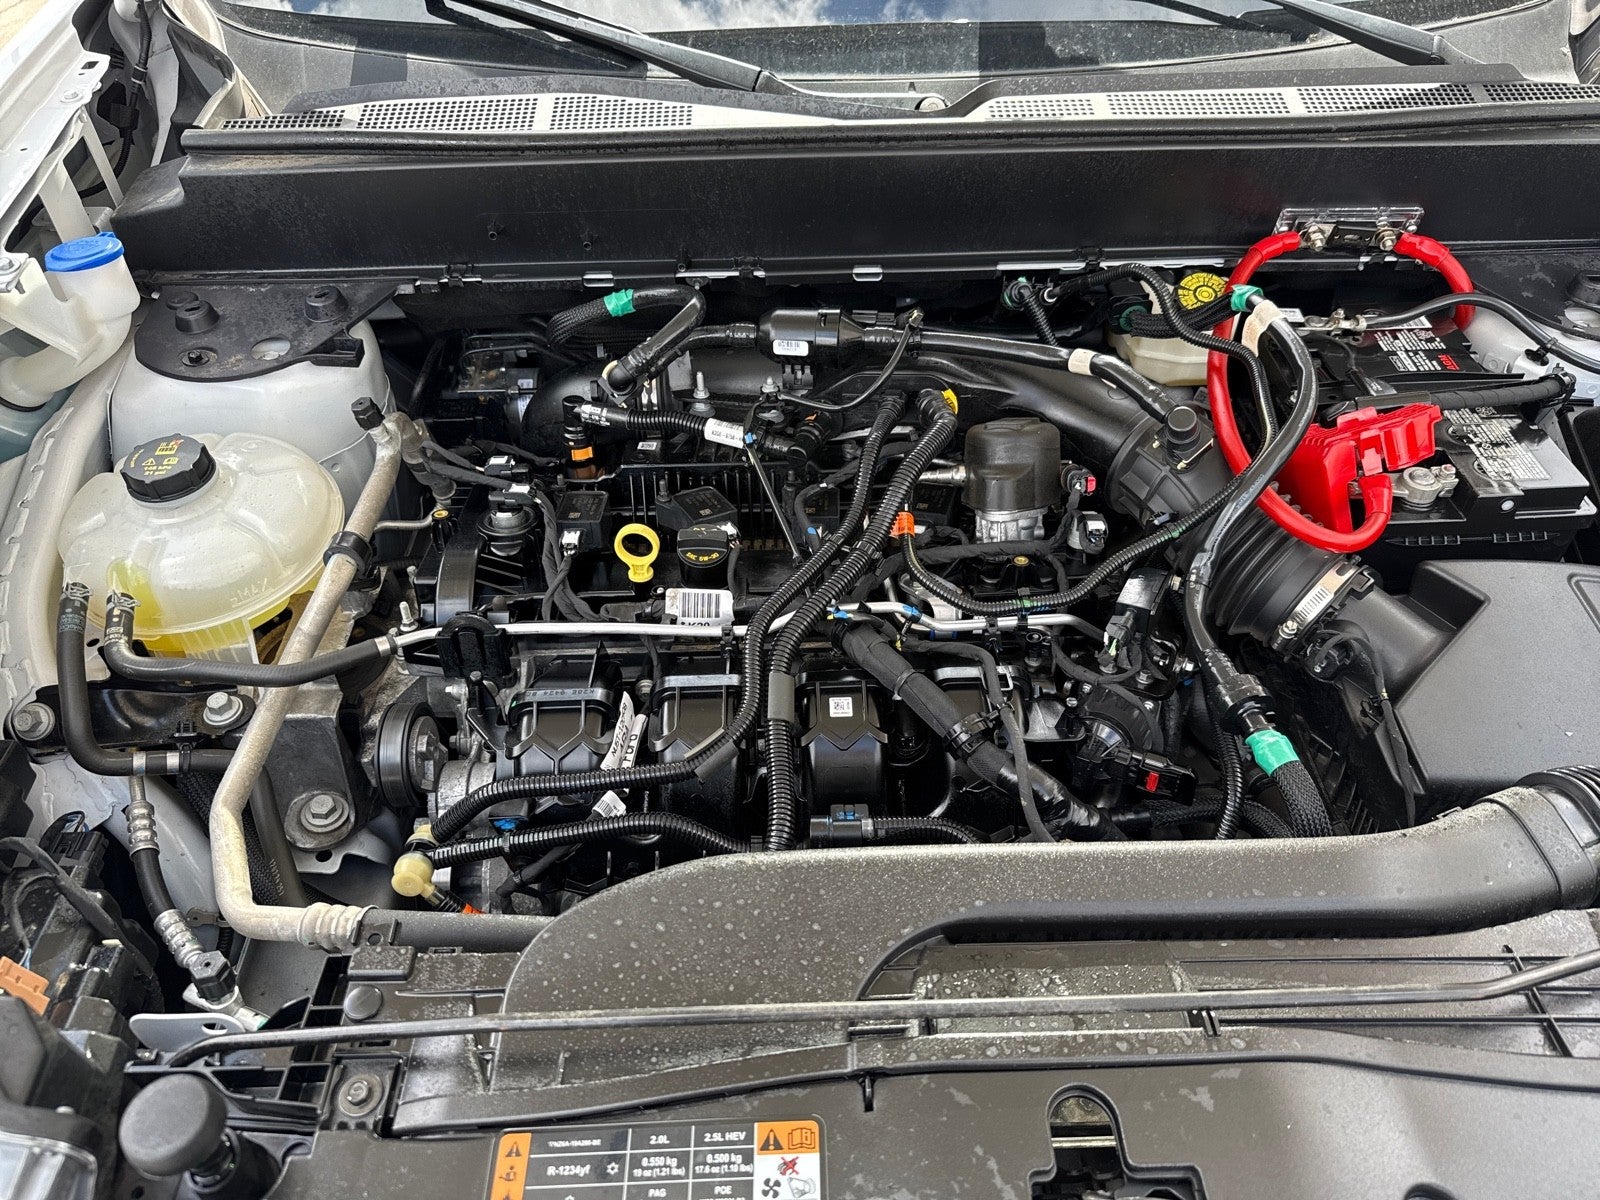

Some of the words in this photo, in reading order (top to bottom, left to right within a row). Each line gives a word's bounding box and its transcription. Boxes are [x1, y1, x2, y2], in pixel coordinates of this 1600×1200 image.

[649, 1135, 670, 1145] 2.0L
[704, 1132, 724, 1142] 2.5L
[725, 1131, 746, 1141] HEV
[666, 1155, 678, 1167] kg
[706, 1153, 730, 1164] 0.500
[730, 1153, 743, 1164] kg
[546, 1164, 591, 1178] R-1234yf
[714, 1186, 732, 1195] POE
